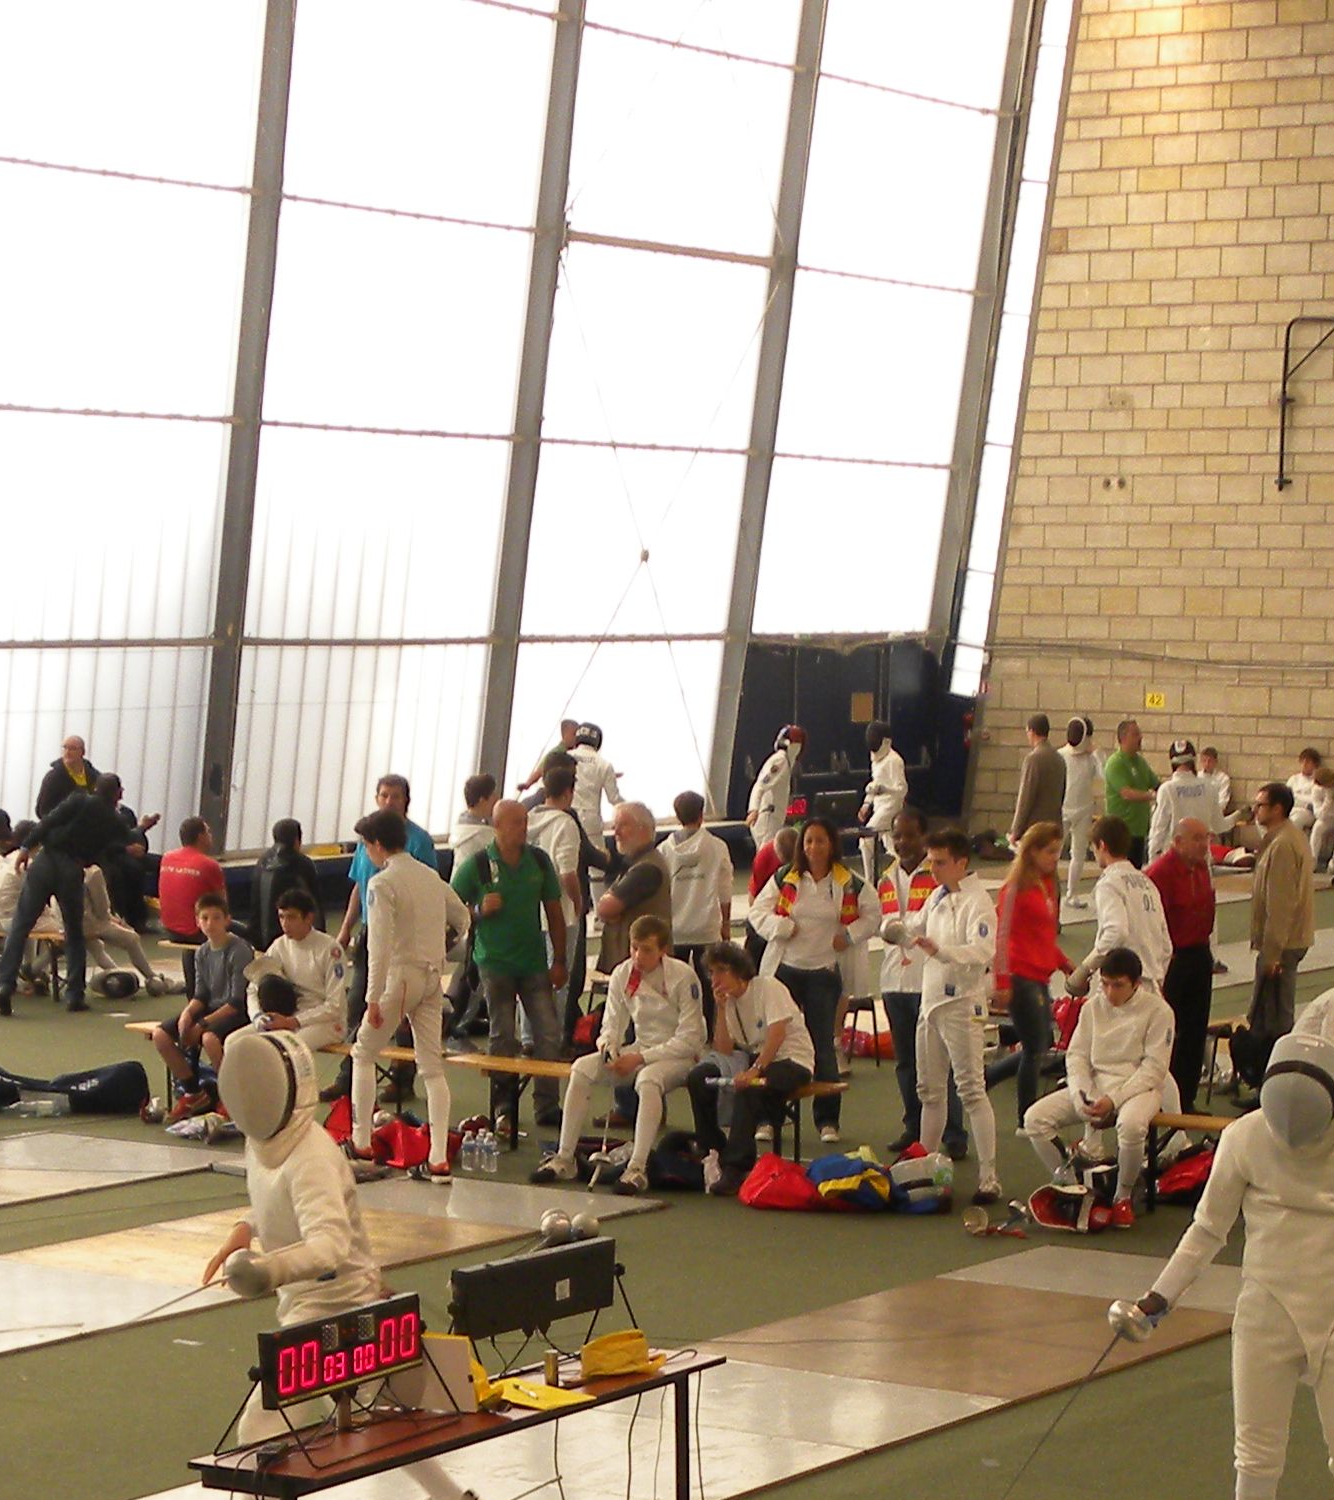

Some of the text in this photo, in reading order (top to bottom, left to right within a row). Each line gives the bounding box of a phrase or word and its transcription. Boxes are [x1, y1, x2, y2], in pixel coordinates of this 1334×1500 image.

[1148, 693, 1163, 706] 42
[278, 1312, 419, 1395] 00 03 00 00
